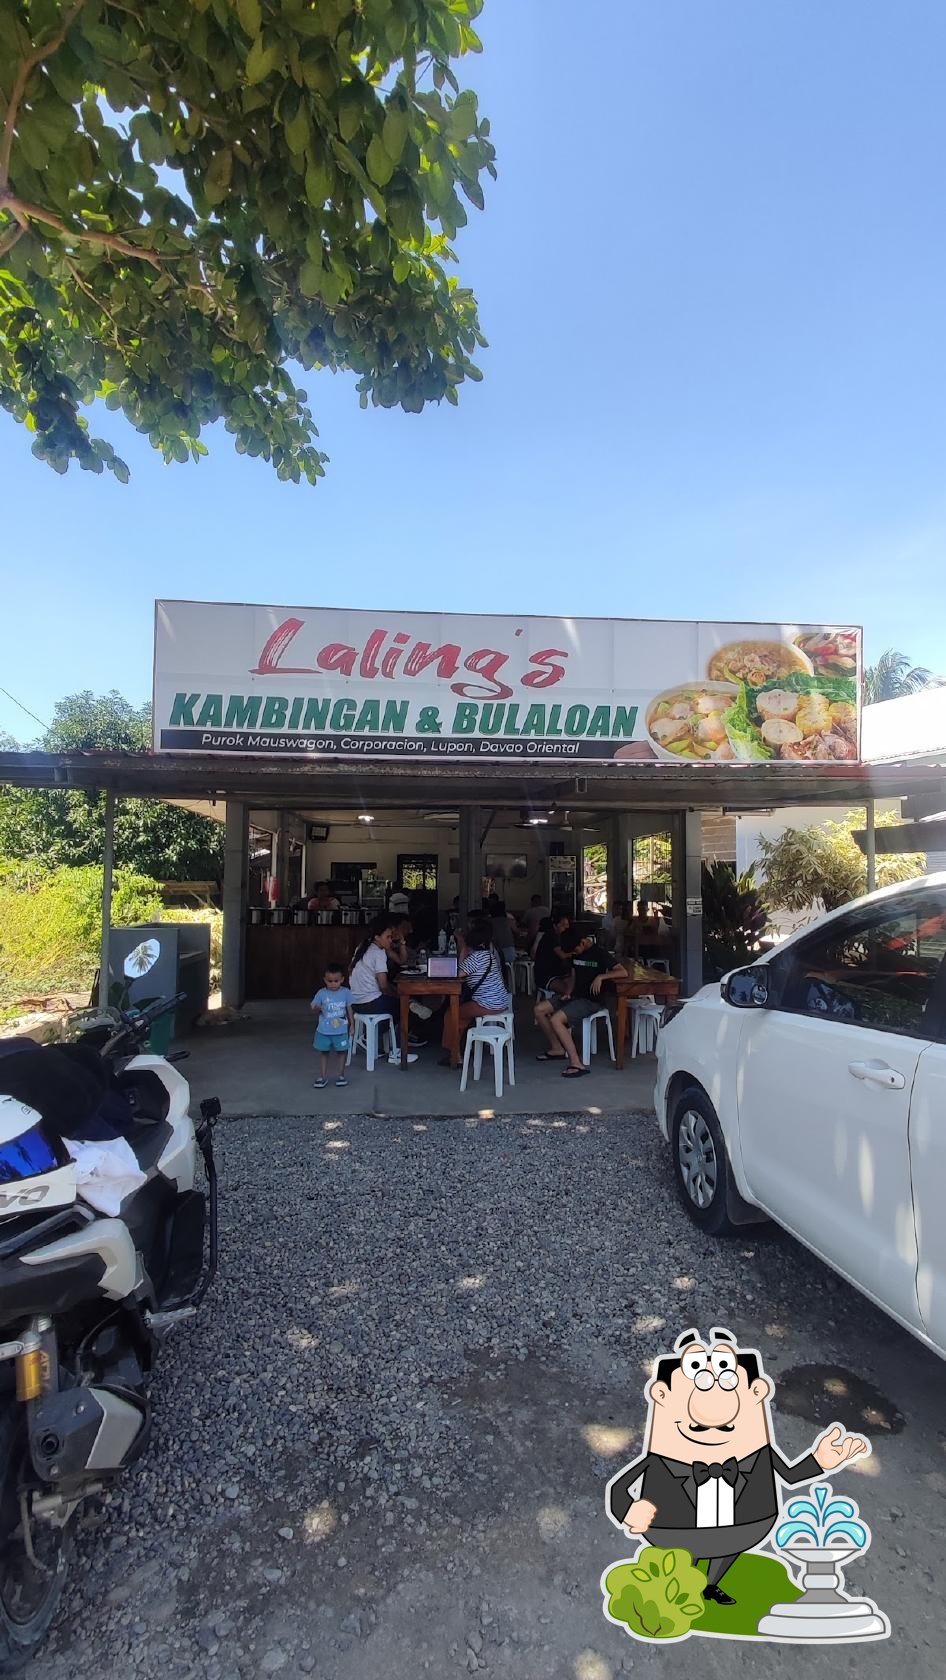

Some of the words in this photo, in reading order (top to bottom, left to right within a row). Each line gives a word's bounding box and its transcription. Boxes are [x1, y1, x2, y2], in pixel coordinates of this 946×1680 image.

[248, 617, 569, 701] Laling's
[169, 692, 410, 734] KAMBINGAN
[415, 705, 443, 735] &
[451, 702, 639, 739] BULALOAN
[201, 733, 244, 747] Purok
[340, 737, 427, 753] Corporacion,
[431, 740, 476, 754] Lupon,
[479, 741, 523, 754] Davao
[526, 741, 580, 754] Oriental
